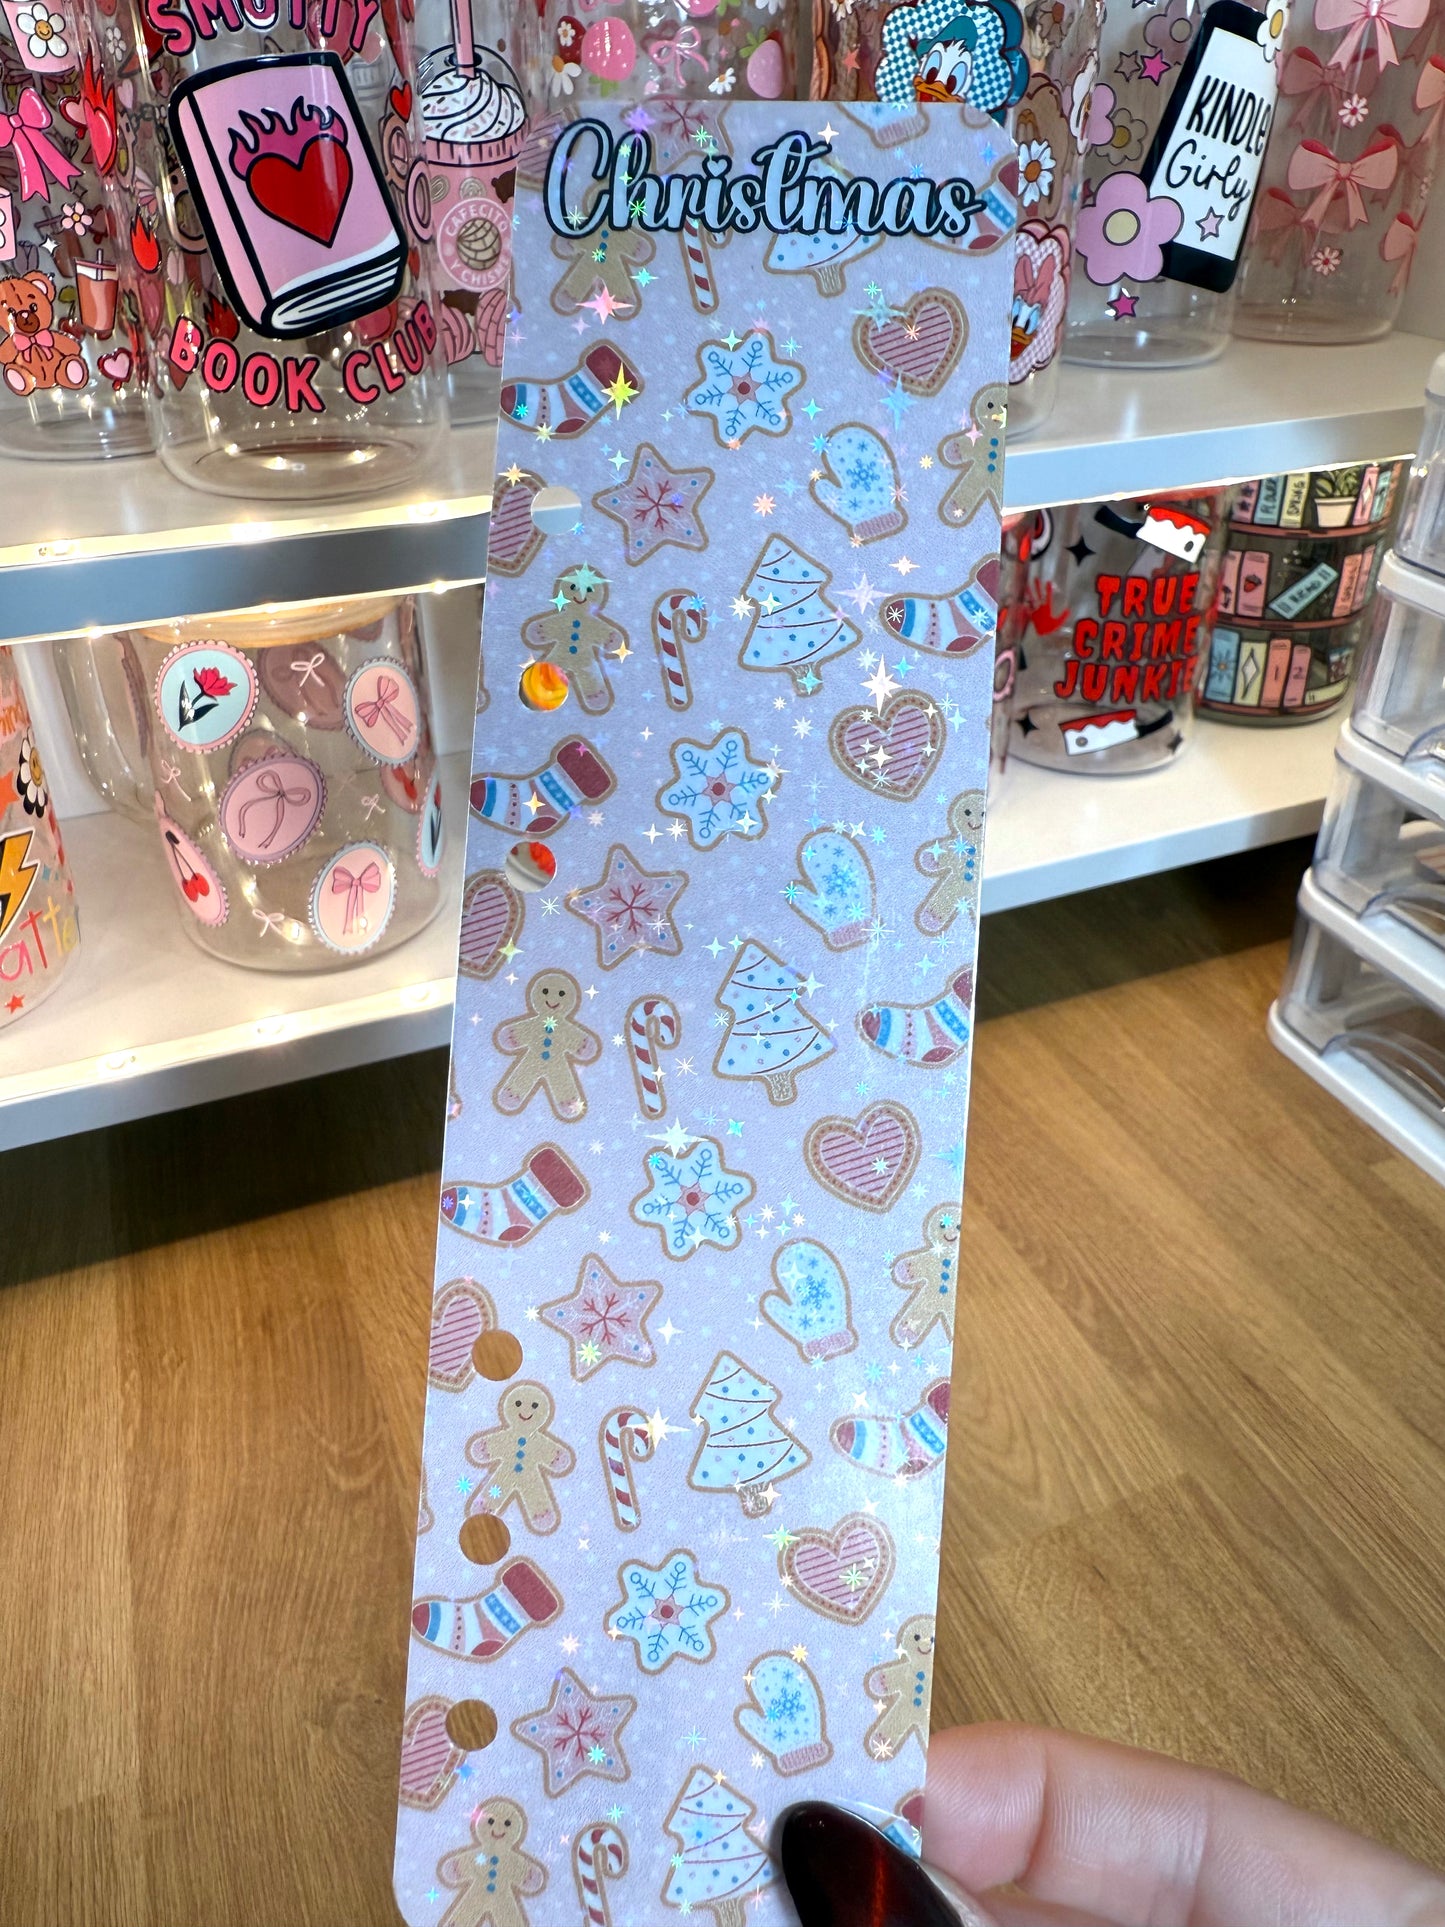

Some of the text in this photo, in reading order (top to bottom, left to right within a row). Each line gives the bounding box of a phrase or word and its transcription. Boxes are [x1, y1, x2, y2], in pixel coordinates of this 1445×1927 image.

[543, 117, 988, 239] Christmas
[1165, 138, 1251, 222] Girly
[445, 203, 508, 237] CAFECITO
[168, 299, 438, 413] BOOK CLUB
[1095, 571, 1201, 618] TRUE
[1073, 614, 1202, 662] CRIME
[1053, 655, 1199, 705] JUNKIE
